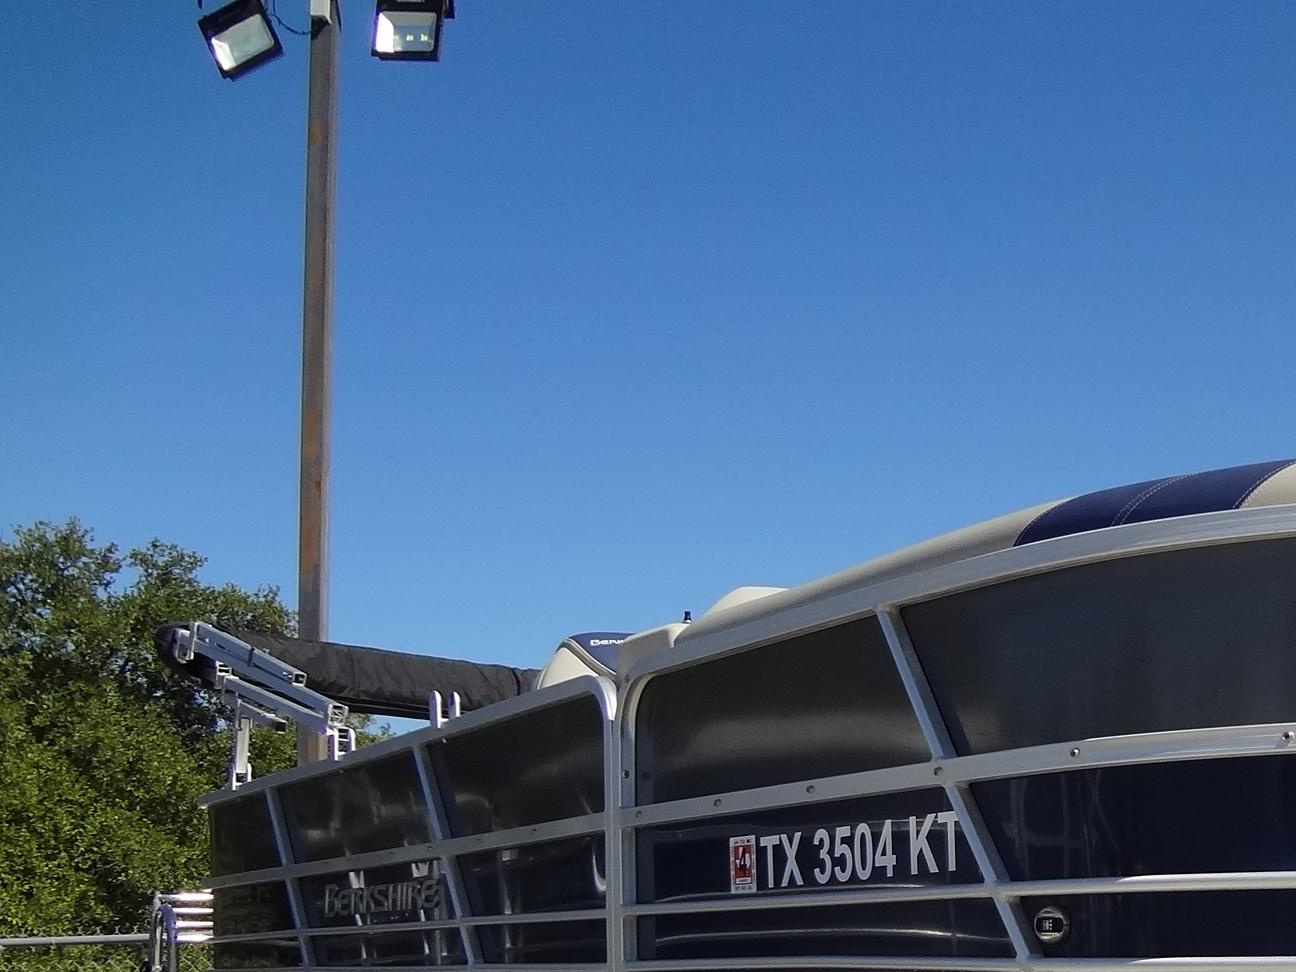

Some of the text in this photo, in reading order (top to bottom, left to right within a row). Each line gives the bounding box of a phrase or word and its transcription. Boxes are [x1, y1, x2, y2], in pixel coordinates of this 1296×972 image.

[760, 810, 959, 888] TX 3504 KT
